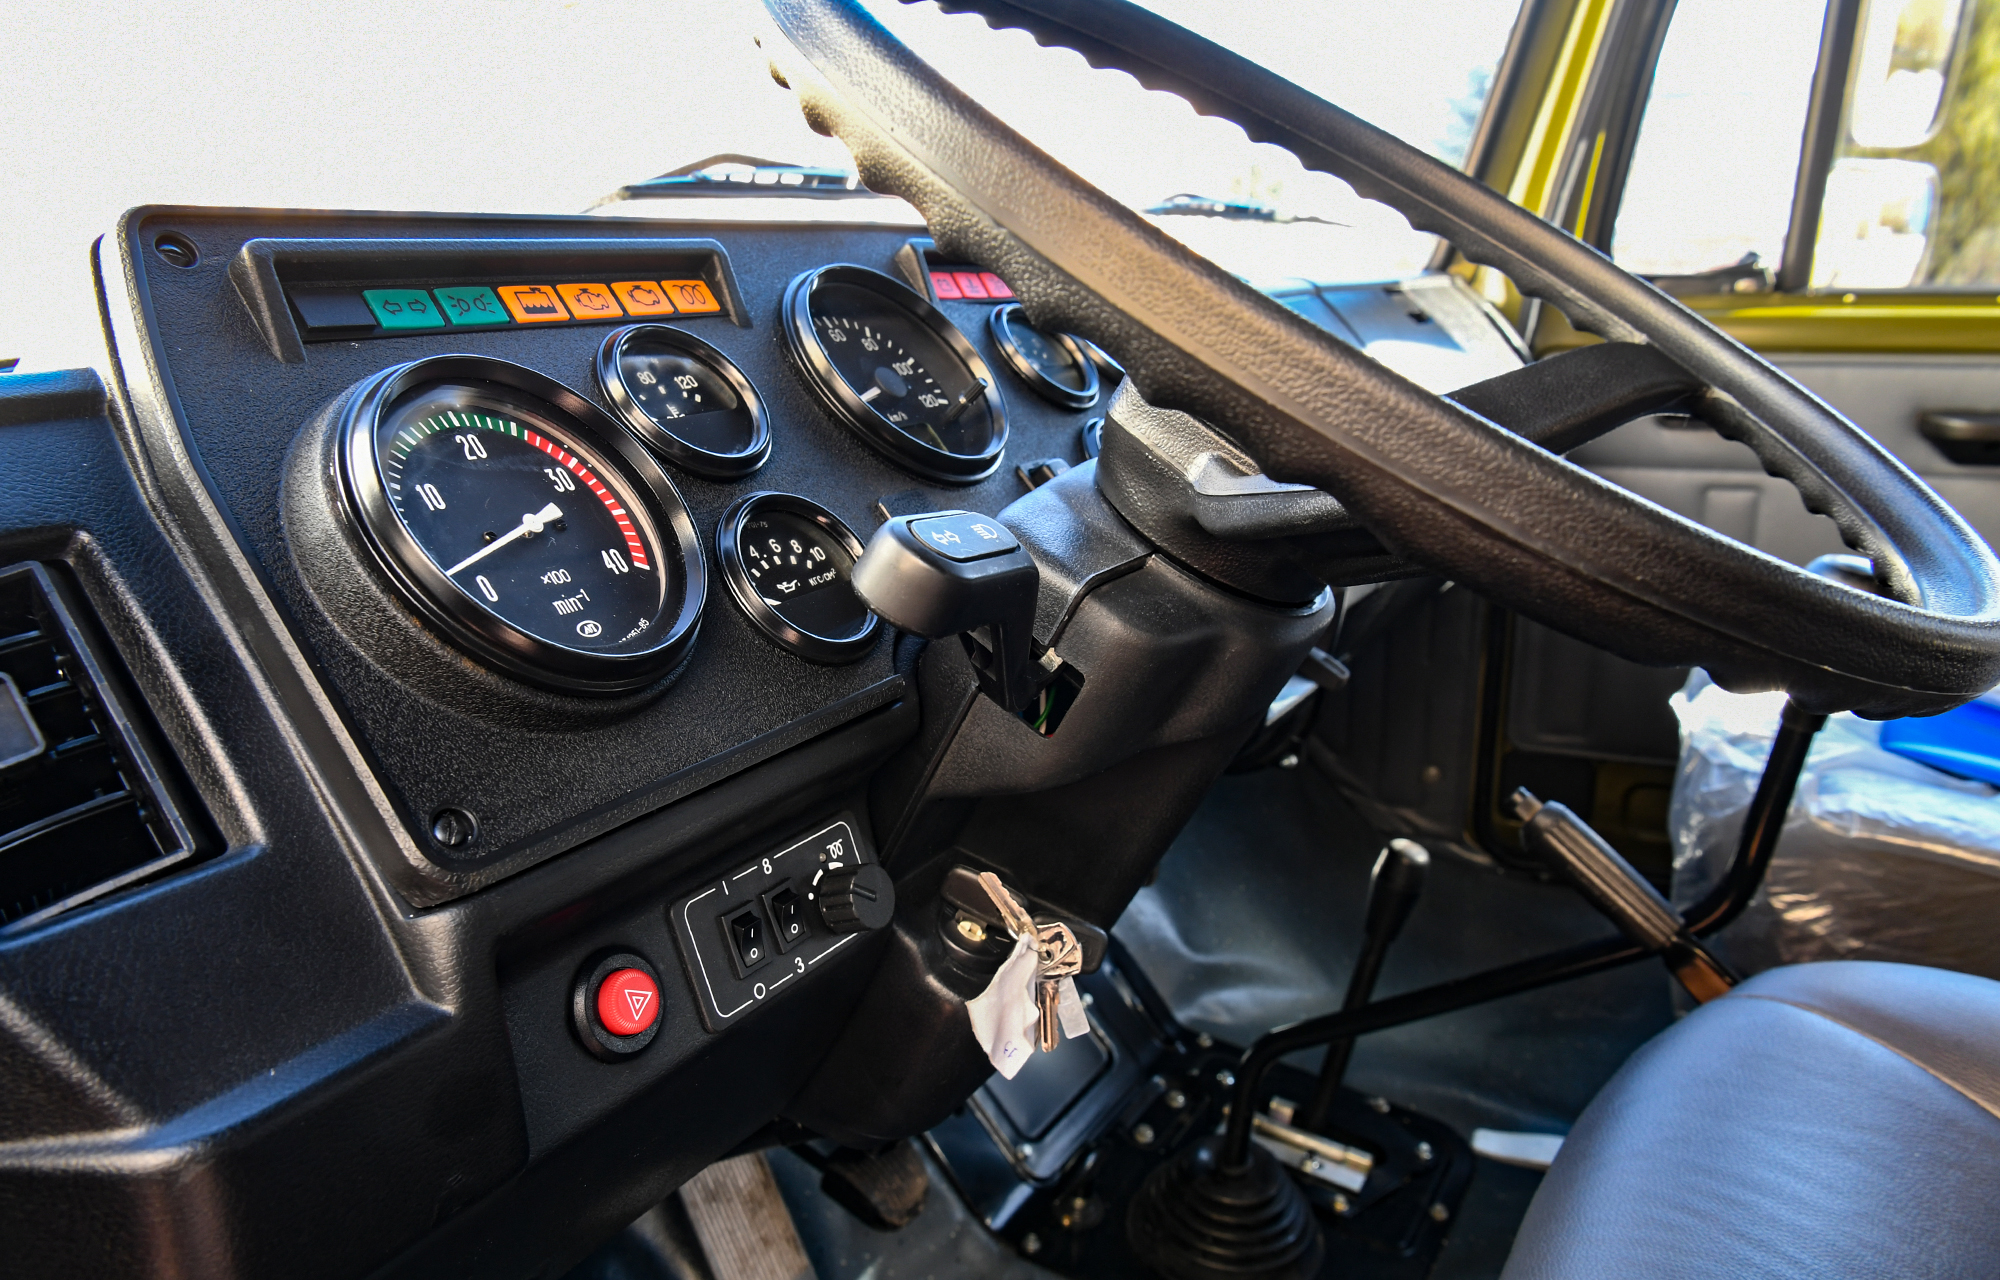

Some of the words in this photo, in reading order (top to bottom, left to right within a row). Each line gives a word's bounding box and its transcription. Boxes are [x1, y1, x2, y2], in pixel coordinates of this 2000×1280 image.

[828, 328, 847, 342] 60
[861, 338, 879, 351] 80
[892, 362, 914, 376] 100
[637, 371, 656, 385] 80
[674, 374, 698, 389] 120
[415, 483, 446, 511] 10
[455, 434, 488, 460] 20
[544, 467, 575, 492] 30
[601, 549, 629, 575] 40
[749, 544, 760, 559] 4
[768, 538, 782, 553] 6
[790, 539, 803, 554] 8
[809, 546, 827, 562] 10
[475, 575, 499, 602] 0
[761, 858, 773, 875] 8
[794, 957, 805, 973] 3
